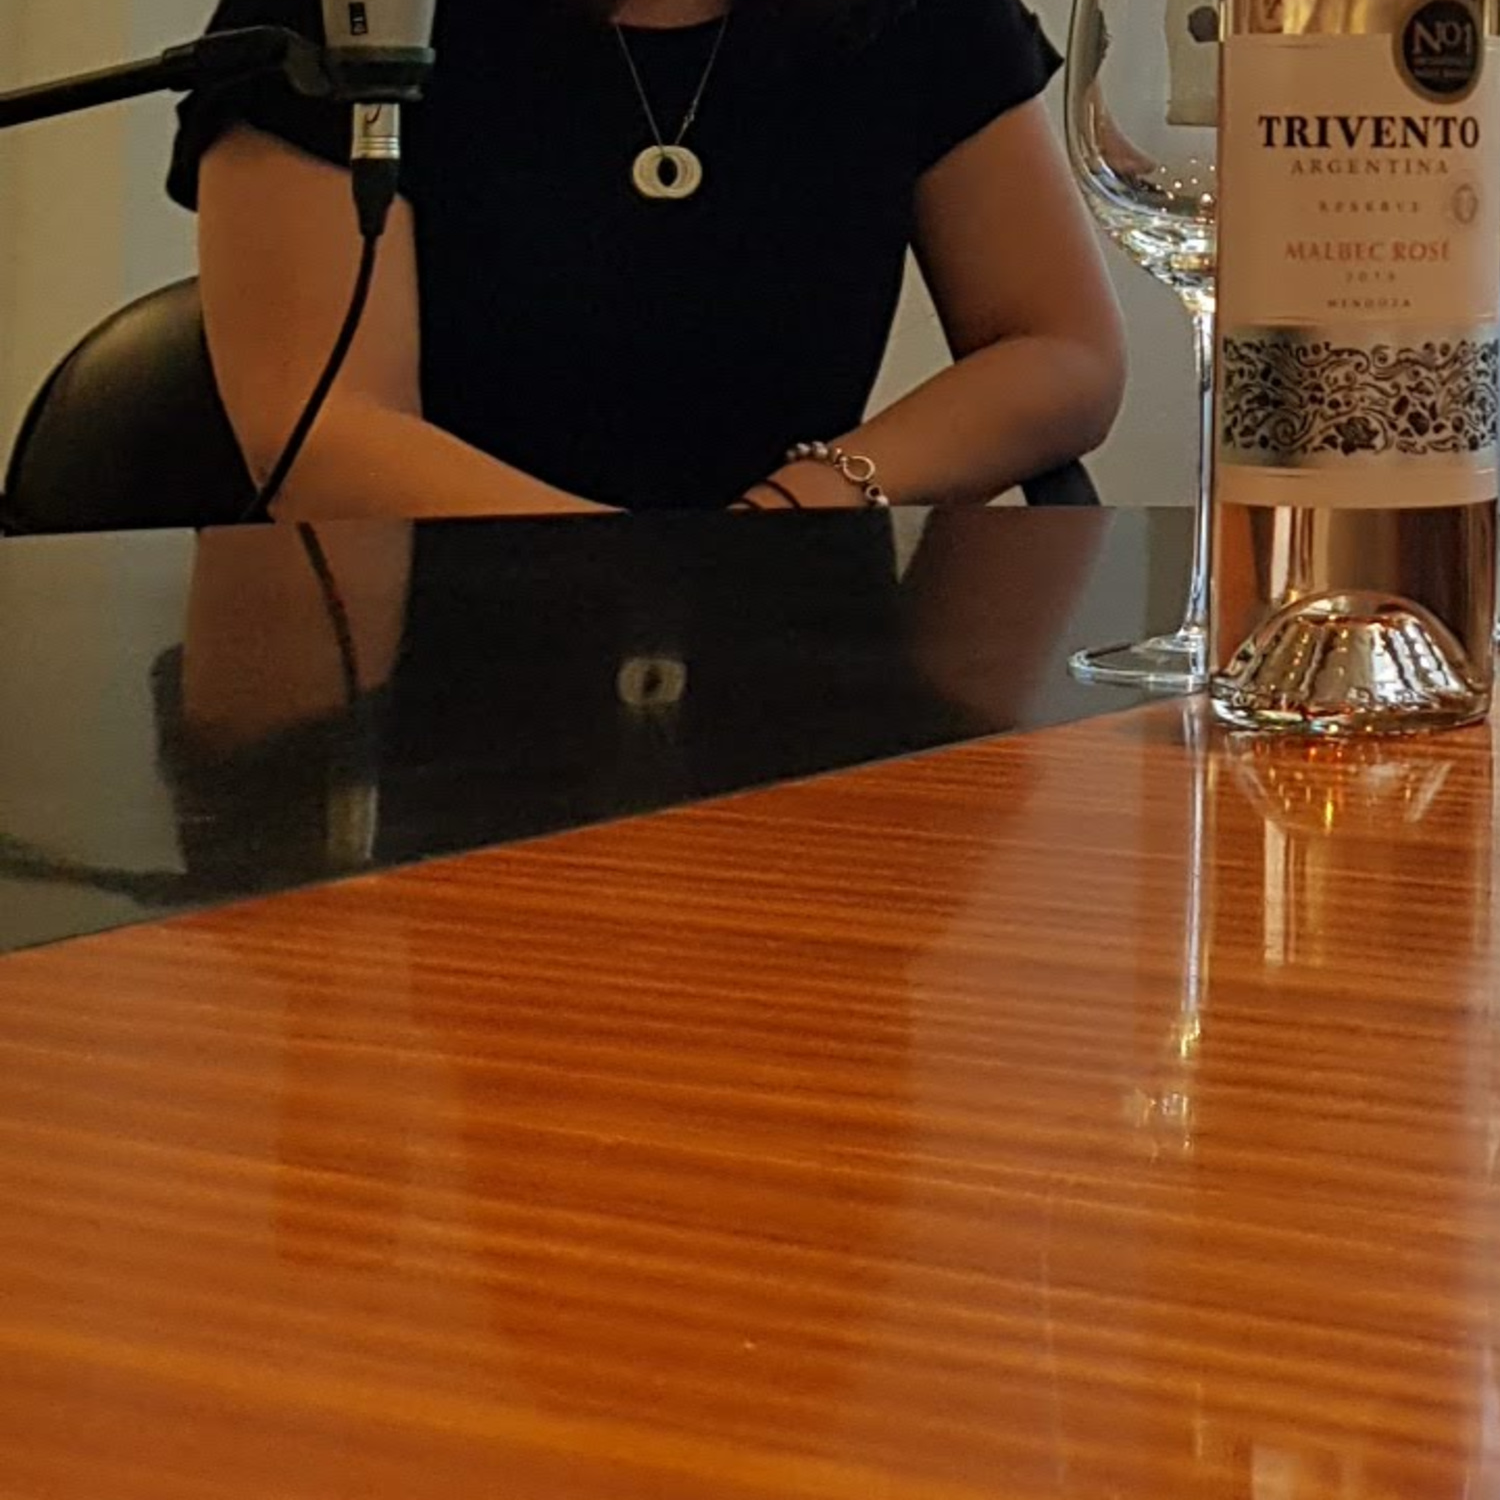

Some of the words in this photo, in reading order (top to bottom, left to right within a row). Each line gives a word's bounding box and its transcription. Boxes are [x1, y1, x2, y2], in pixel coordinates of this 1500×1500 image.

[1258, 115, 1480, 149] TRIVENTO
[1291, 158, 1449, 175] ARGENTINA
[1284, 240, 1386, 262] MALBEC
